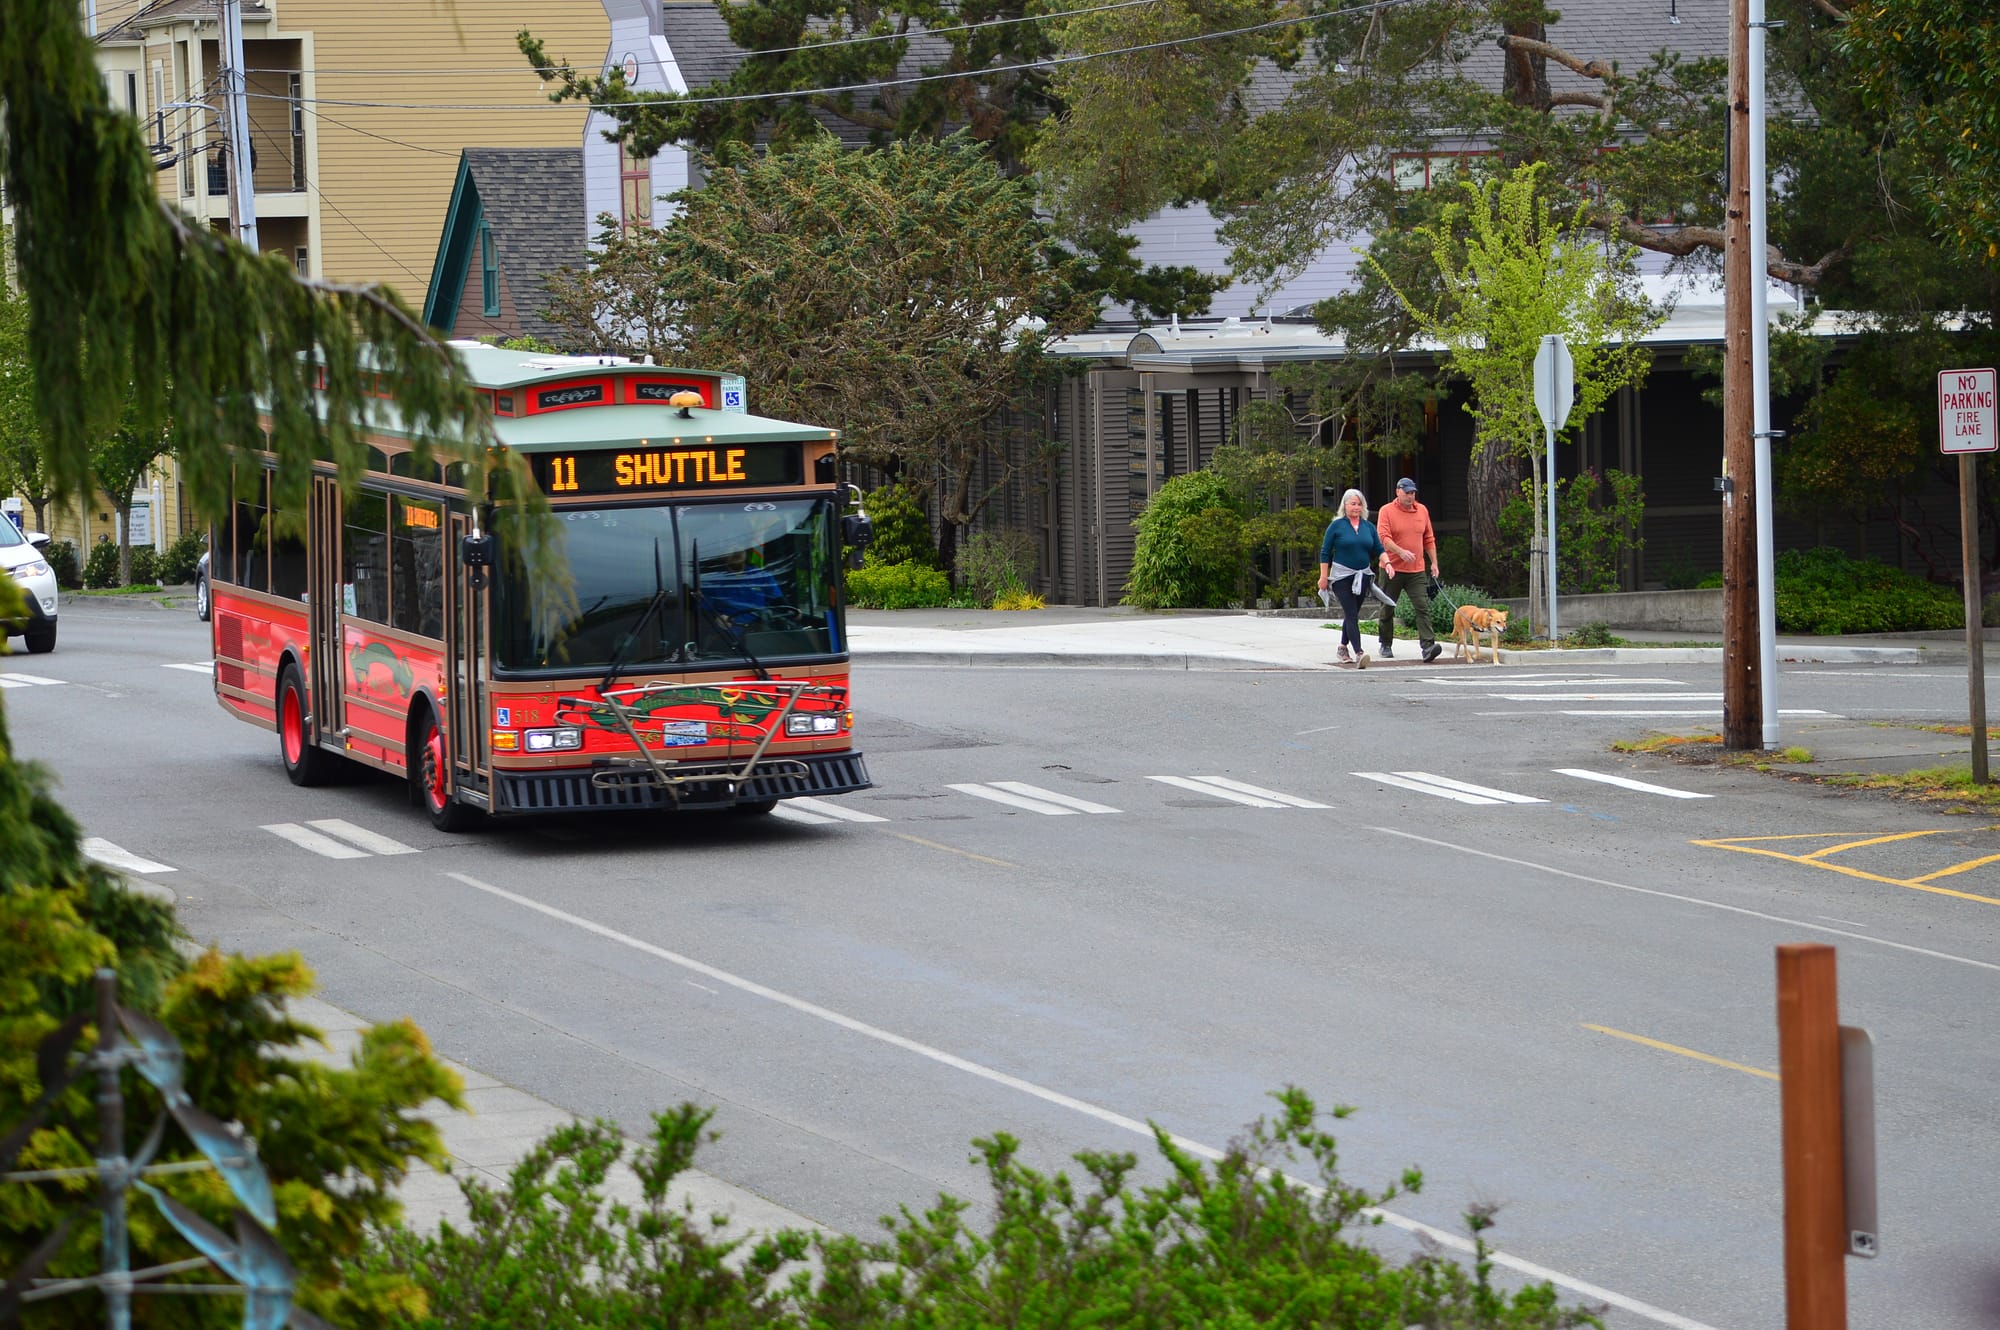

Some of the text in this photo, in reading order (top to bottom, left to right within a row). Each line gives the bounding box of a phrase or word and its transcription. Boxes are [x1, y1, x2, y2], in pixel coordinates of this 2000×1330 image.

[1958, 375, 1977, 390] NO
[1944, 392, 1992, 410] PARKING
[1957, 412, 1979, 423] FIRE
[1955, 424, 1982, 436] LANE
[551, 449, 746, 491] 11 SHUTTLE
[514, 709, 540, 724] 518
